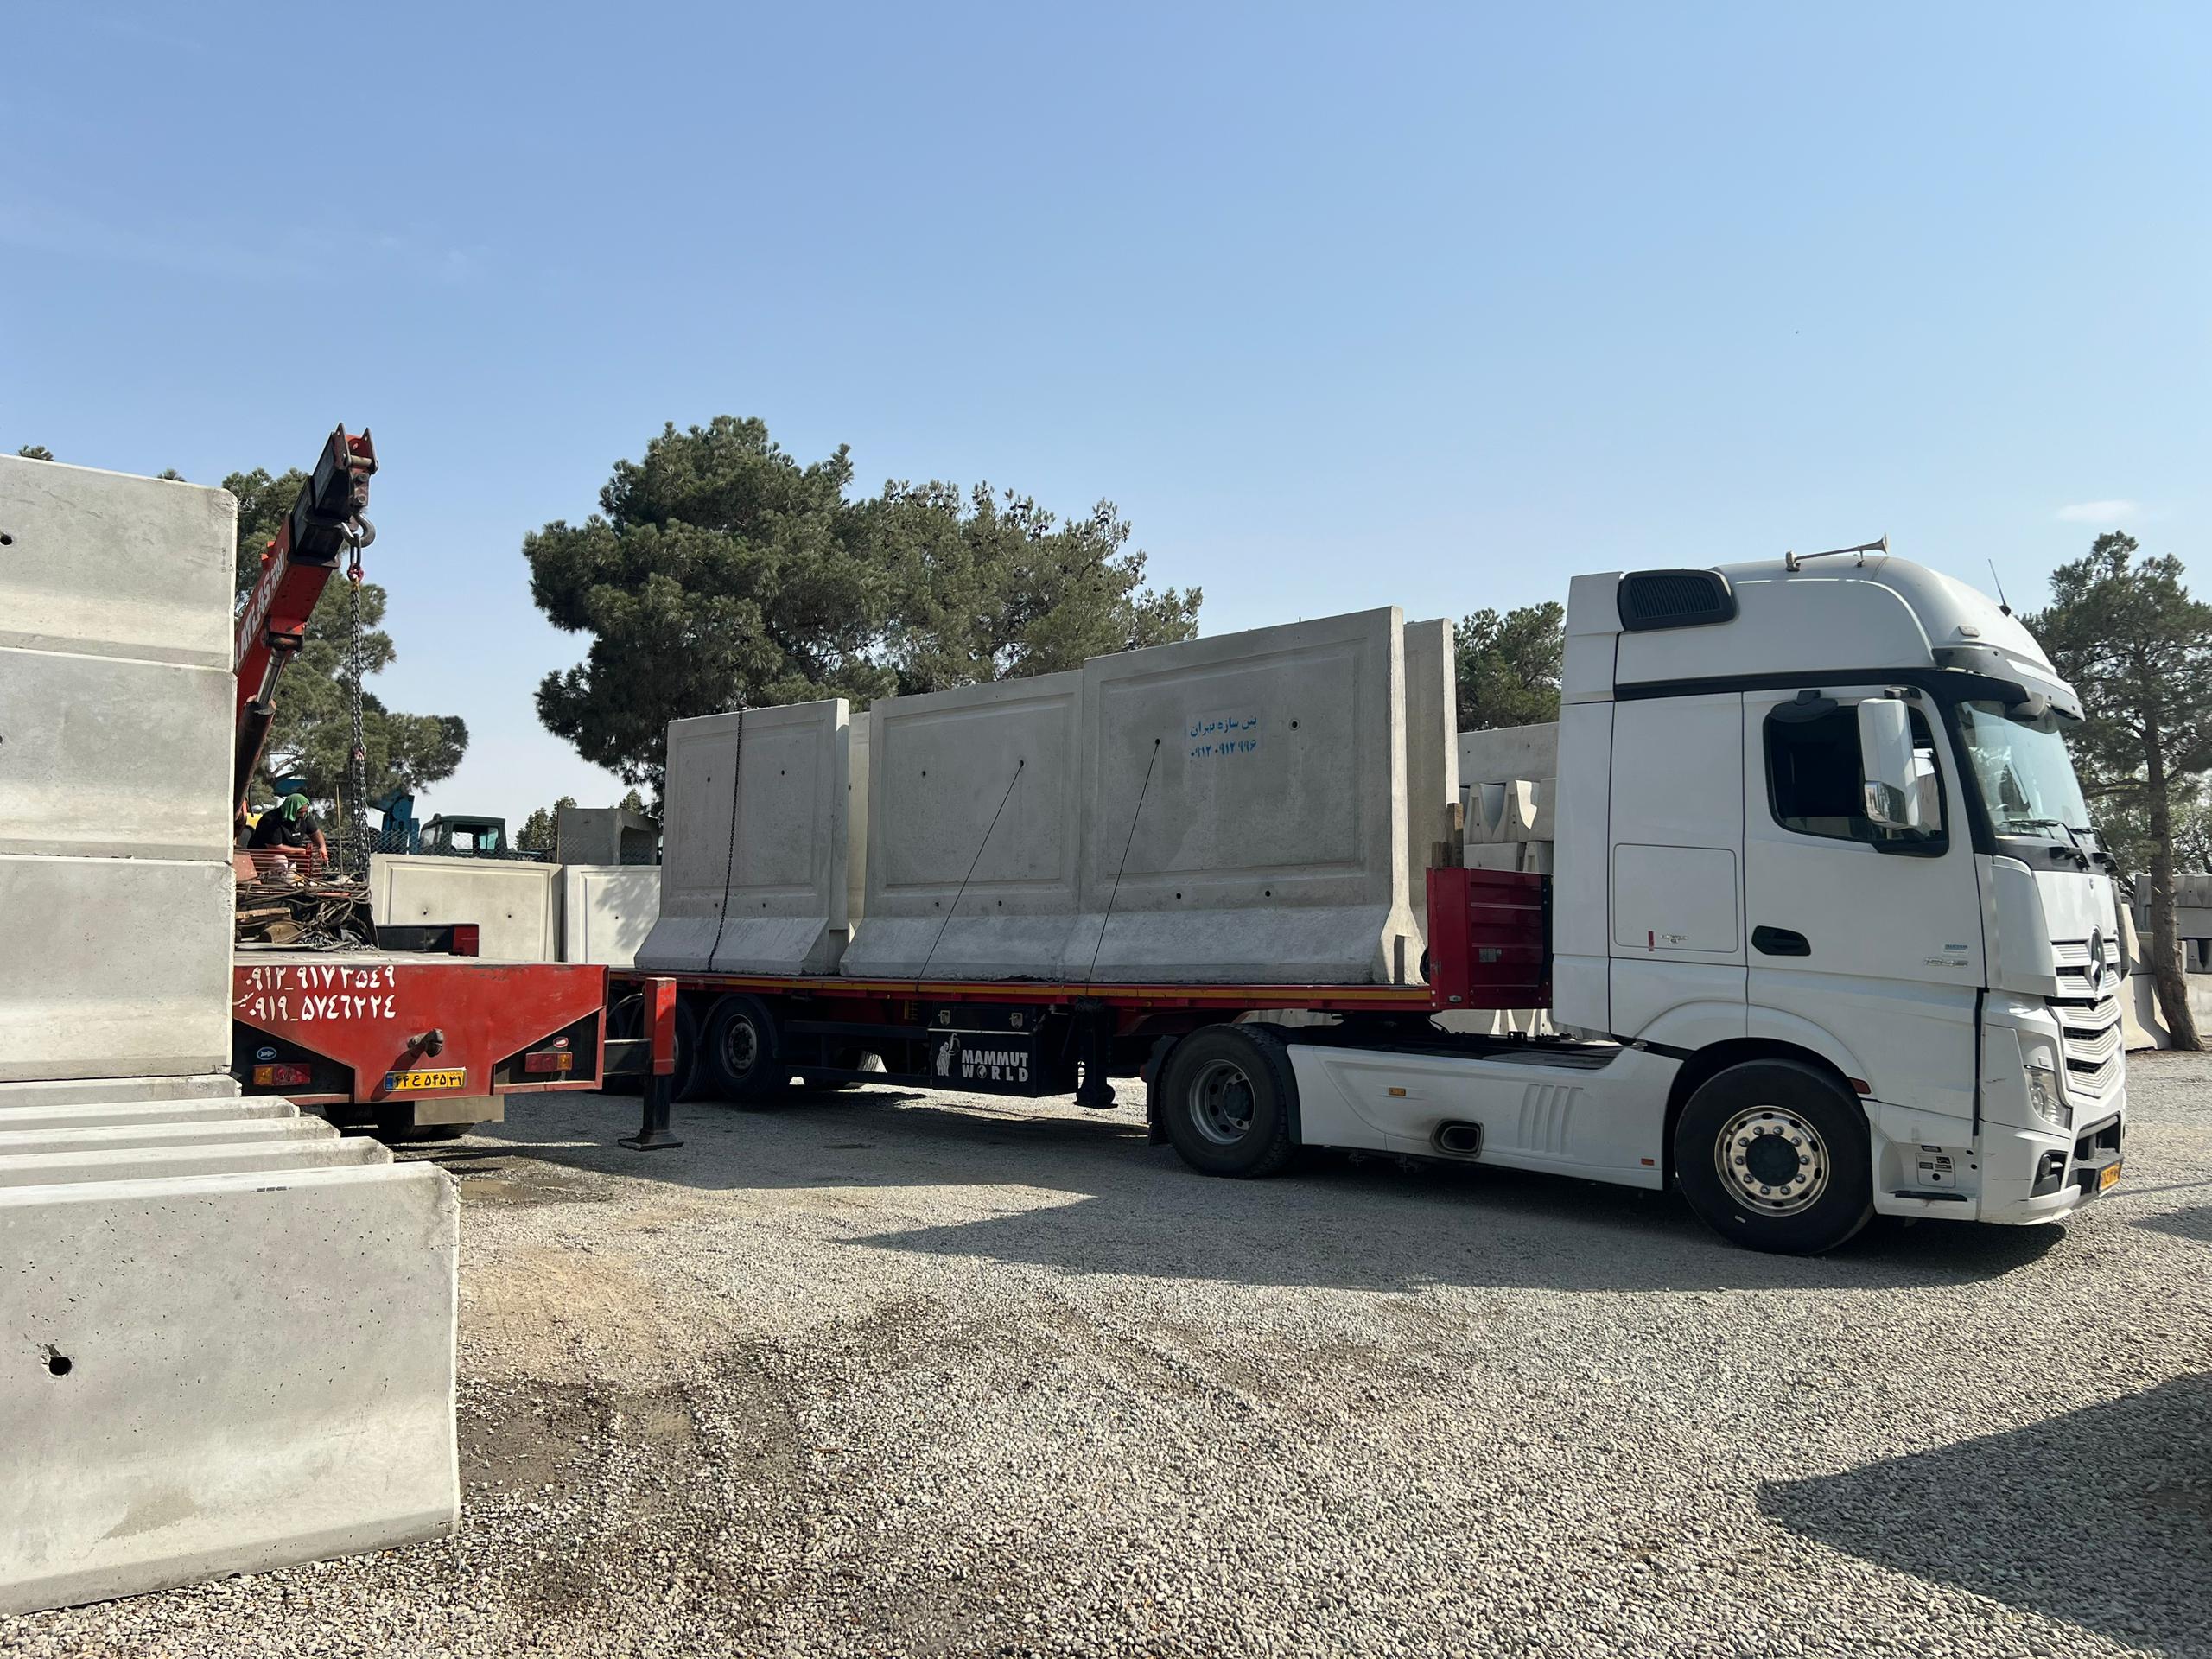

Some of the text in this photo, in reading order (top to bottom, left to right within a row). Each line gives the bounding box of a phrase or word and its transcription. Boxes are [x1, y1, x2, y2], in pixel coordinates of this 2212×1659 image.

[1217, 717, 1239, 734] سازه
[962, 1049, 1028, 1068] MAMMUT
[962, 1065, 1028, 1082] WORLD
